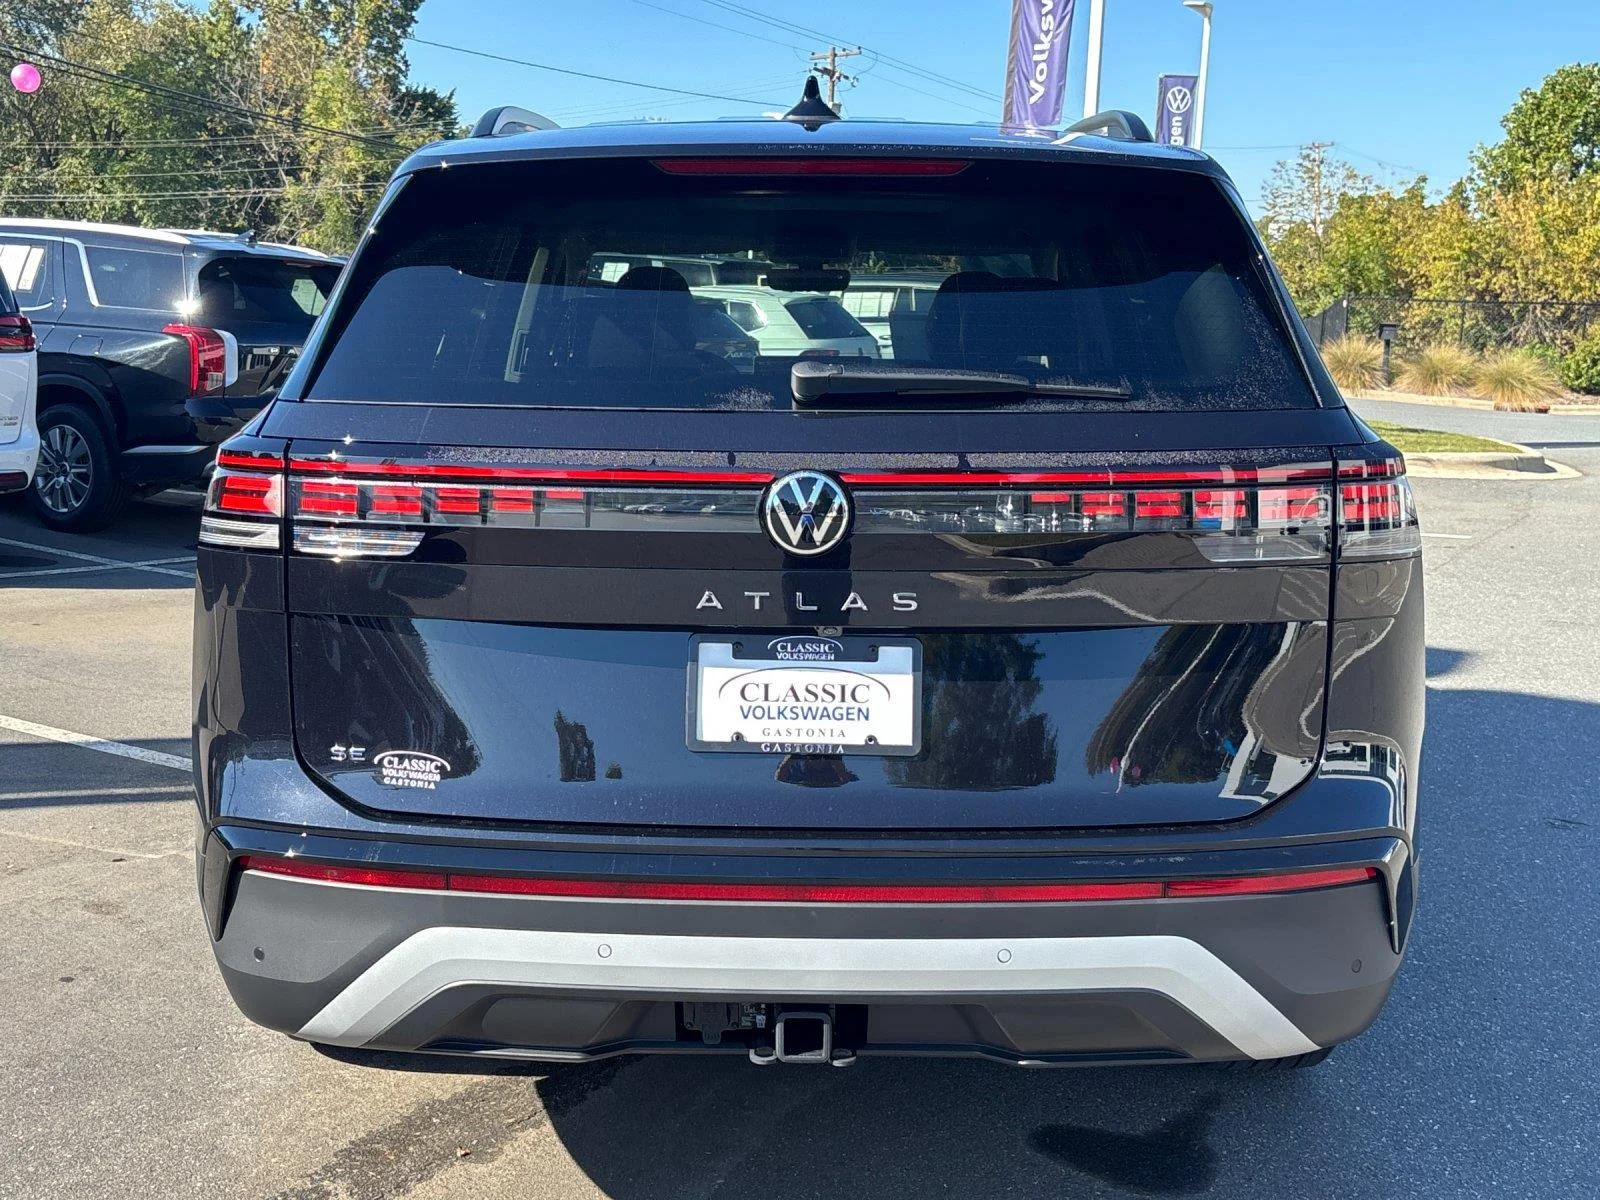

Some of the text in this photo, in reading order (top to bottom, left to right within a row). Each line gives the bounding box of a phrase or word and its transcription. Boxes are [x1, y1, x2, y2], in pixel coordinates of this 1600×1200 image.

[1170, 116, 1185, 146] gen
[768, 473, 846, 551] VW
[696, 590, 918, 612] ATLAS
[776, 642, 835, 653] CLASSIC
[776, 652, 835, 661] VOLKSWAGEN
[739, 682, 871, 704] CLASSIC
[739, 705, 870, 721] VOLKSWAGEN
[762, 727, 846, 738] GASTONIA
[330, 745, 366, 761] SE
[761, 743, 845, 754] GASTONIA
[383, 756, 441, 773] CLASSIC
[382, 767, 441, 782] VOLKSWAGEN
[383, 778, 436, 790] GASTONIA
